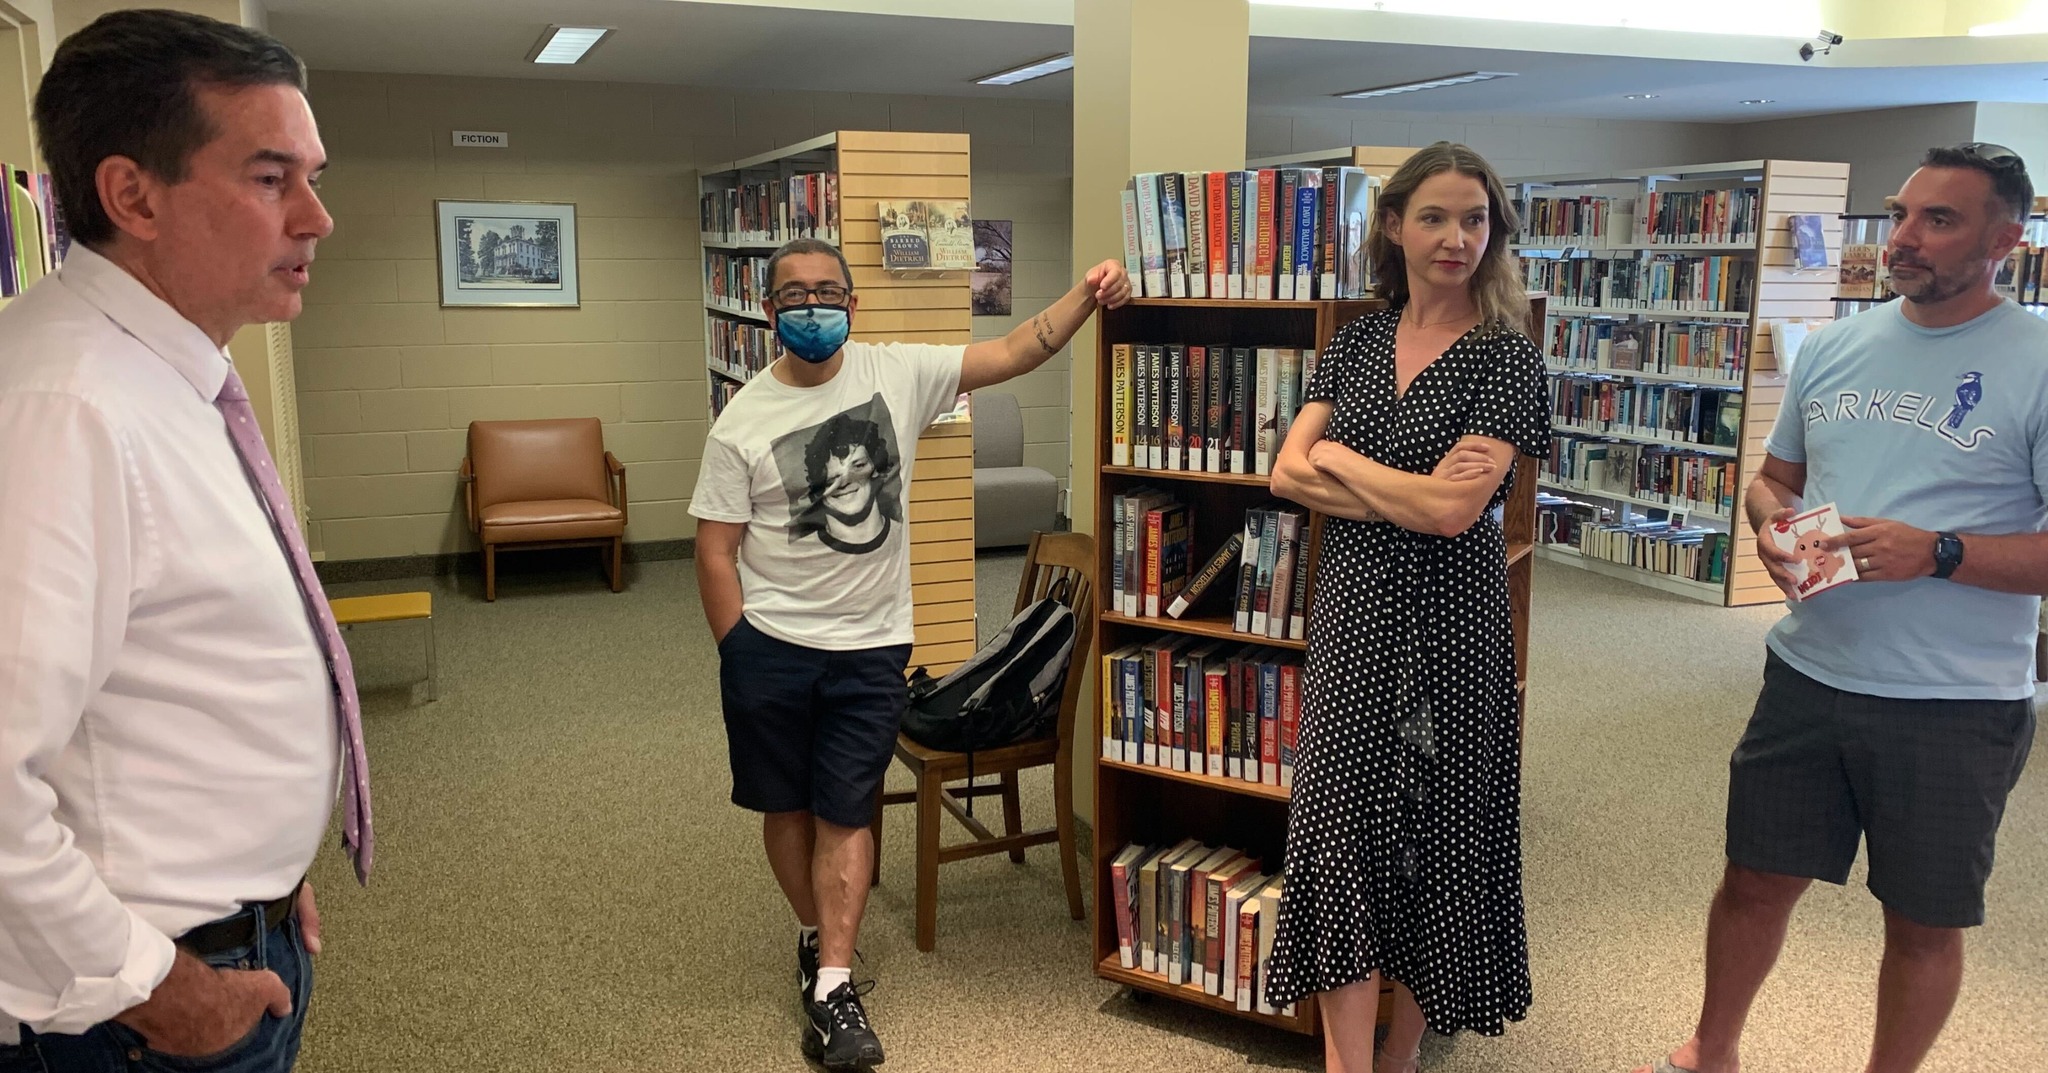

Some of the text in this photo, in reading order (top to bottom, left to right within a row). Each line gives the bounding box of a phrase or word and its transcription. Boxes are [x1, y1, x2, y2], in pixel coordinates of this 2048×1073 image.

[461, 134, 499, 144] FICTION
[1164, 176, 1176, 202] DAVID
[1213, 189, 1221, 210] DAVID
[1232, 187, 1240, 207] DAVID
[1260, 186, 1271, 212] DAVID
[1285, 185, 1293, 207] DAVID
[1326, 184, 1335, 204] DAVID
[1126, 202, 1134, 222] DAVID
[1188, 177, 1202, 258] DAVID BALDACCI
[1284, 208, 1293, 242] BALDACCI
[1303, 206, 1311, 227] DAVID
[1326, 206, 1335, 242] BALDACCI
[1126, 224, 1136, 256] BALDACCI
[1214, 213, 1222, 248] BALDACCI
[1232, 210, 1240, 243] BALDACCI
[1258, 214, 1270, 258] BALDACCI
[1301, 229, 1310, 261] BALDACCI
[1151, 352, 1159, 378] JAMES
[1192, 352, 1200, 378] JAMES
[1260, 357, 1268, 375] JAMES
[1281, 357, 1290, 378] JAMES
[1305, 356, 1314, 376] JAMES
[1116, 349, 1125, 434] JAMES PATTERSON
[1137, 351, 1145, 426] JAMES PATTERSON
[1171, 352, 1179, 427] JAMES PATTERSON
[1210, 352, 1219, 429] JAMES PATTERSON
[1259, 377, 1268, 408] PATTERSON
[1281, 379, 1289, 416] PATTERSON
[1806, 388, 1996, 452] ARKELLS
[1136, 434, 1147, 445] 14
[1150, 435, 1160, 445] 16
[1170, 436, 1180, 447] 18
[1189, 436, 1201, 448] 20
[1207, 437, 1220, 450] 21
[1126, 503, 1135, 521] JAMES
[1264, 516, 1276, 536] JAMES
[1126, 522, 1134, 551] PATTERSON
[1148, 526, 1158, 547] JAMES
[1282, 524, 1291, 540] JAMES
[1147, 549, 1158, 584] PATTERSON
[1279, 540, 1290, 569] PATTERSON
[1190, 548, 1232, 595] JAMES PATTERSON
[1294, 540, 1308, 608] JAMES PATTERSON
[1125, 673, 1135, 690] JAMES
[1174, 683, 1184, 702] JAMES
[1265, 672, 1274, 688] JAMES
[1284, 672, 1294, 691] JAMES
[1126, 690, 1135, 718] PATTERSON
[1264, 688, 1274, 718] PATTERSON
[1283, 691, 1293, 722] PATTERSON
[1174, 703, 1184, 732] PATTERSON
[1209, 688, 1220, 747] JAMES PATTERSON
[1246, 712, 1255, 742] PRIVATE
[1231, 722, 1241, 753] PRIVATE
[1206, 882, 1219, 938] JAMES PATTERSON
[1242, 928, 1252, 945] JAMES
[1241, 946, 1251, 977] PATTERSON
